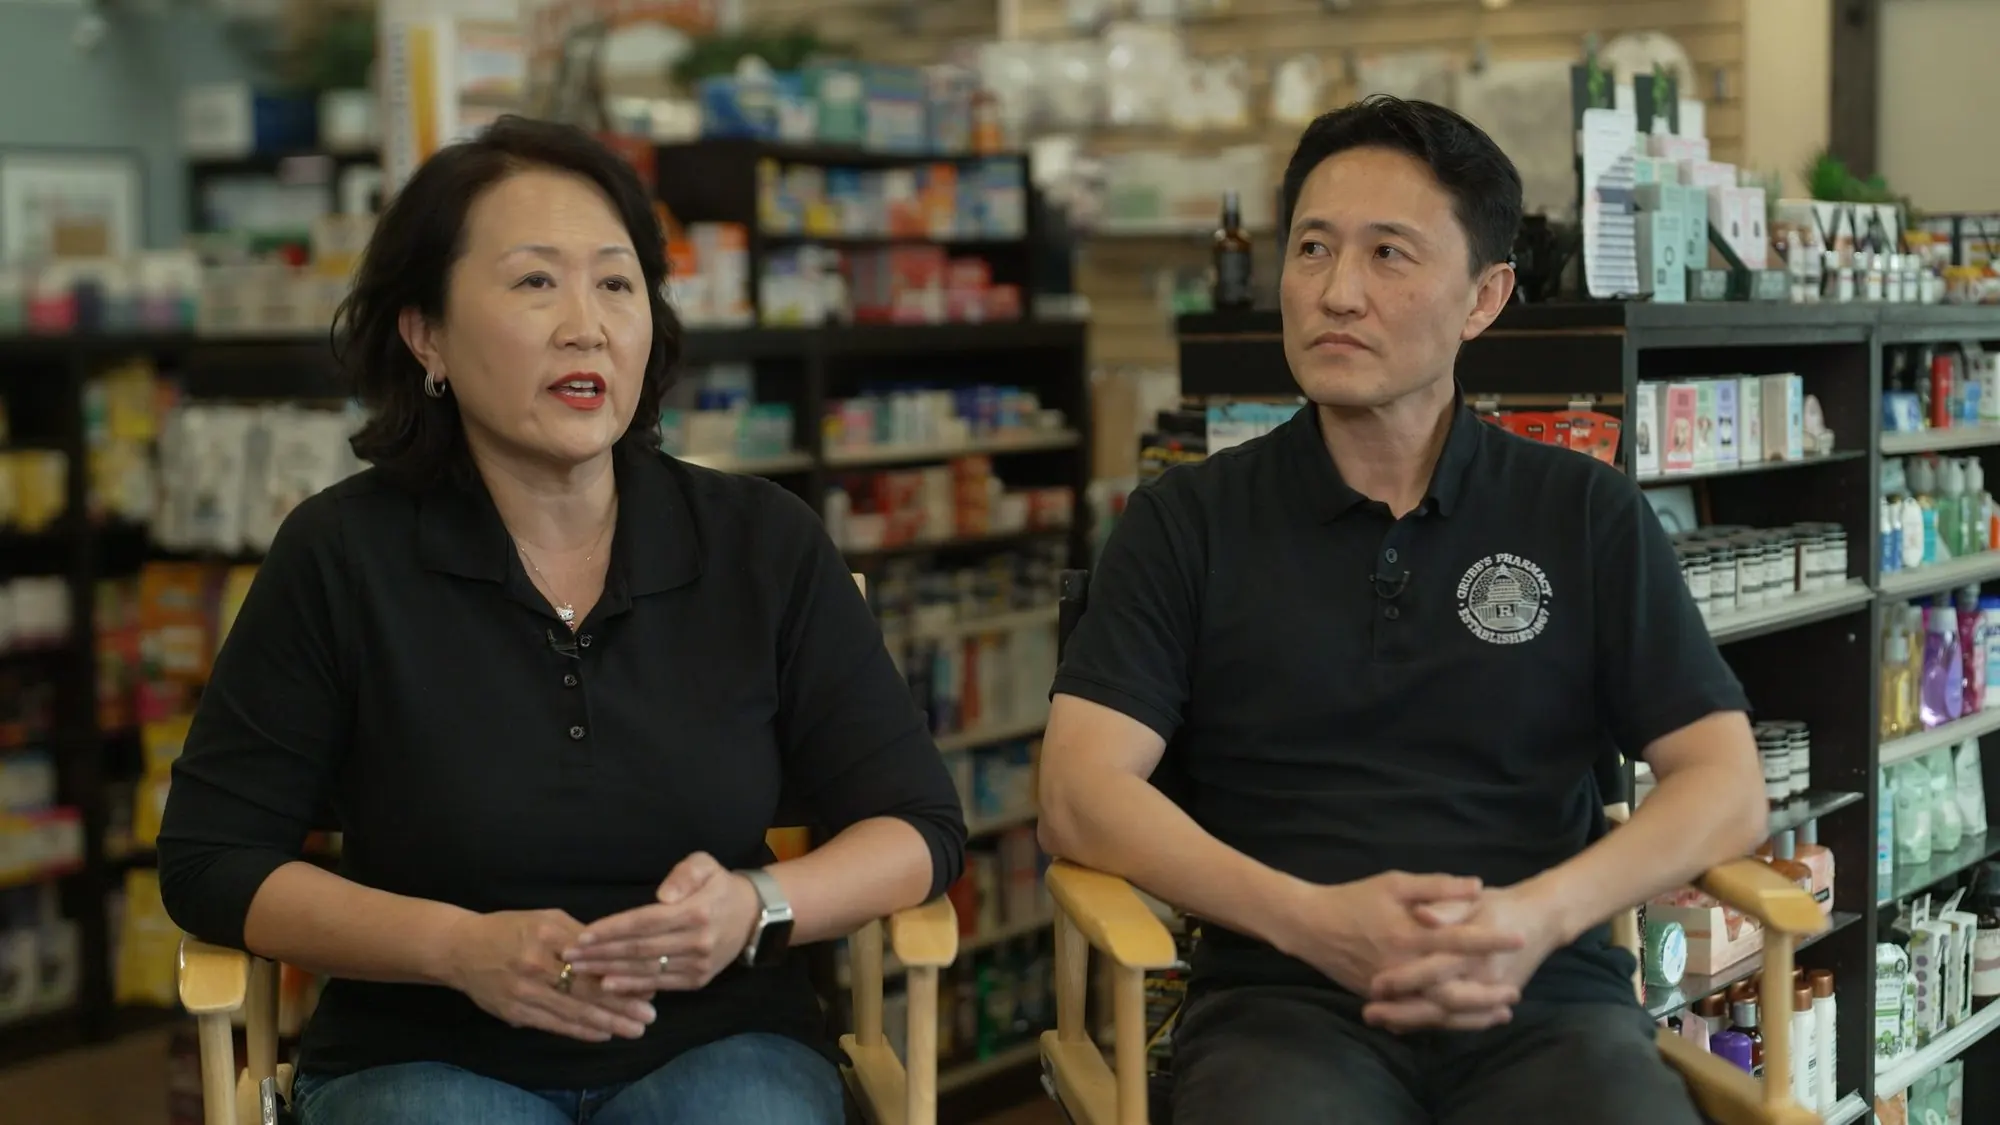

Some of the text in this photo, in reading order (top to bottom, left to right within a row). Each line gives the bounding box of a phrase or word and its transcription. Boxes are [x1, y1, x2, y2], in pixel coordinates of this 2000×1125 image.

[1457, 553, 1553, 599] GRUBB'S PHARMACY
[1458, 607, 1535, 644] ESTABLISHED
